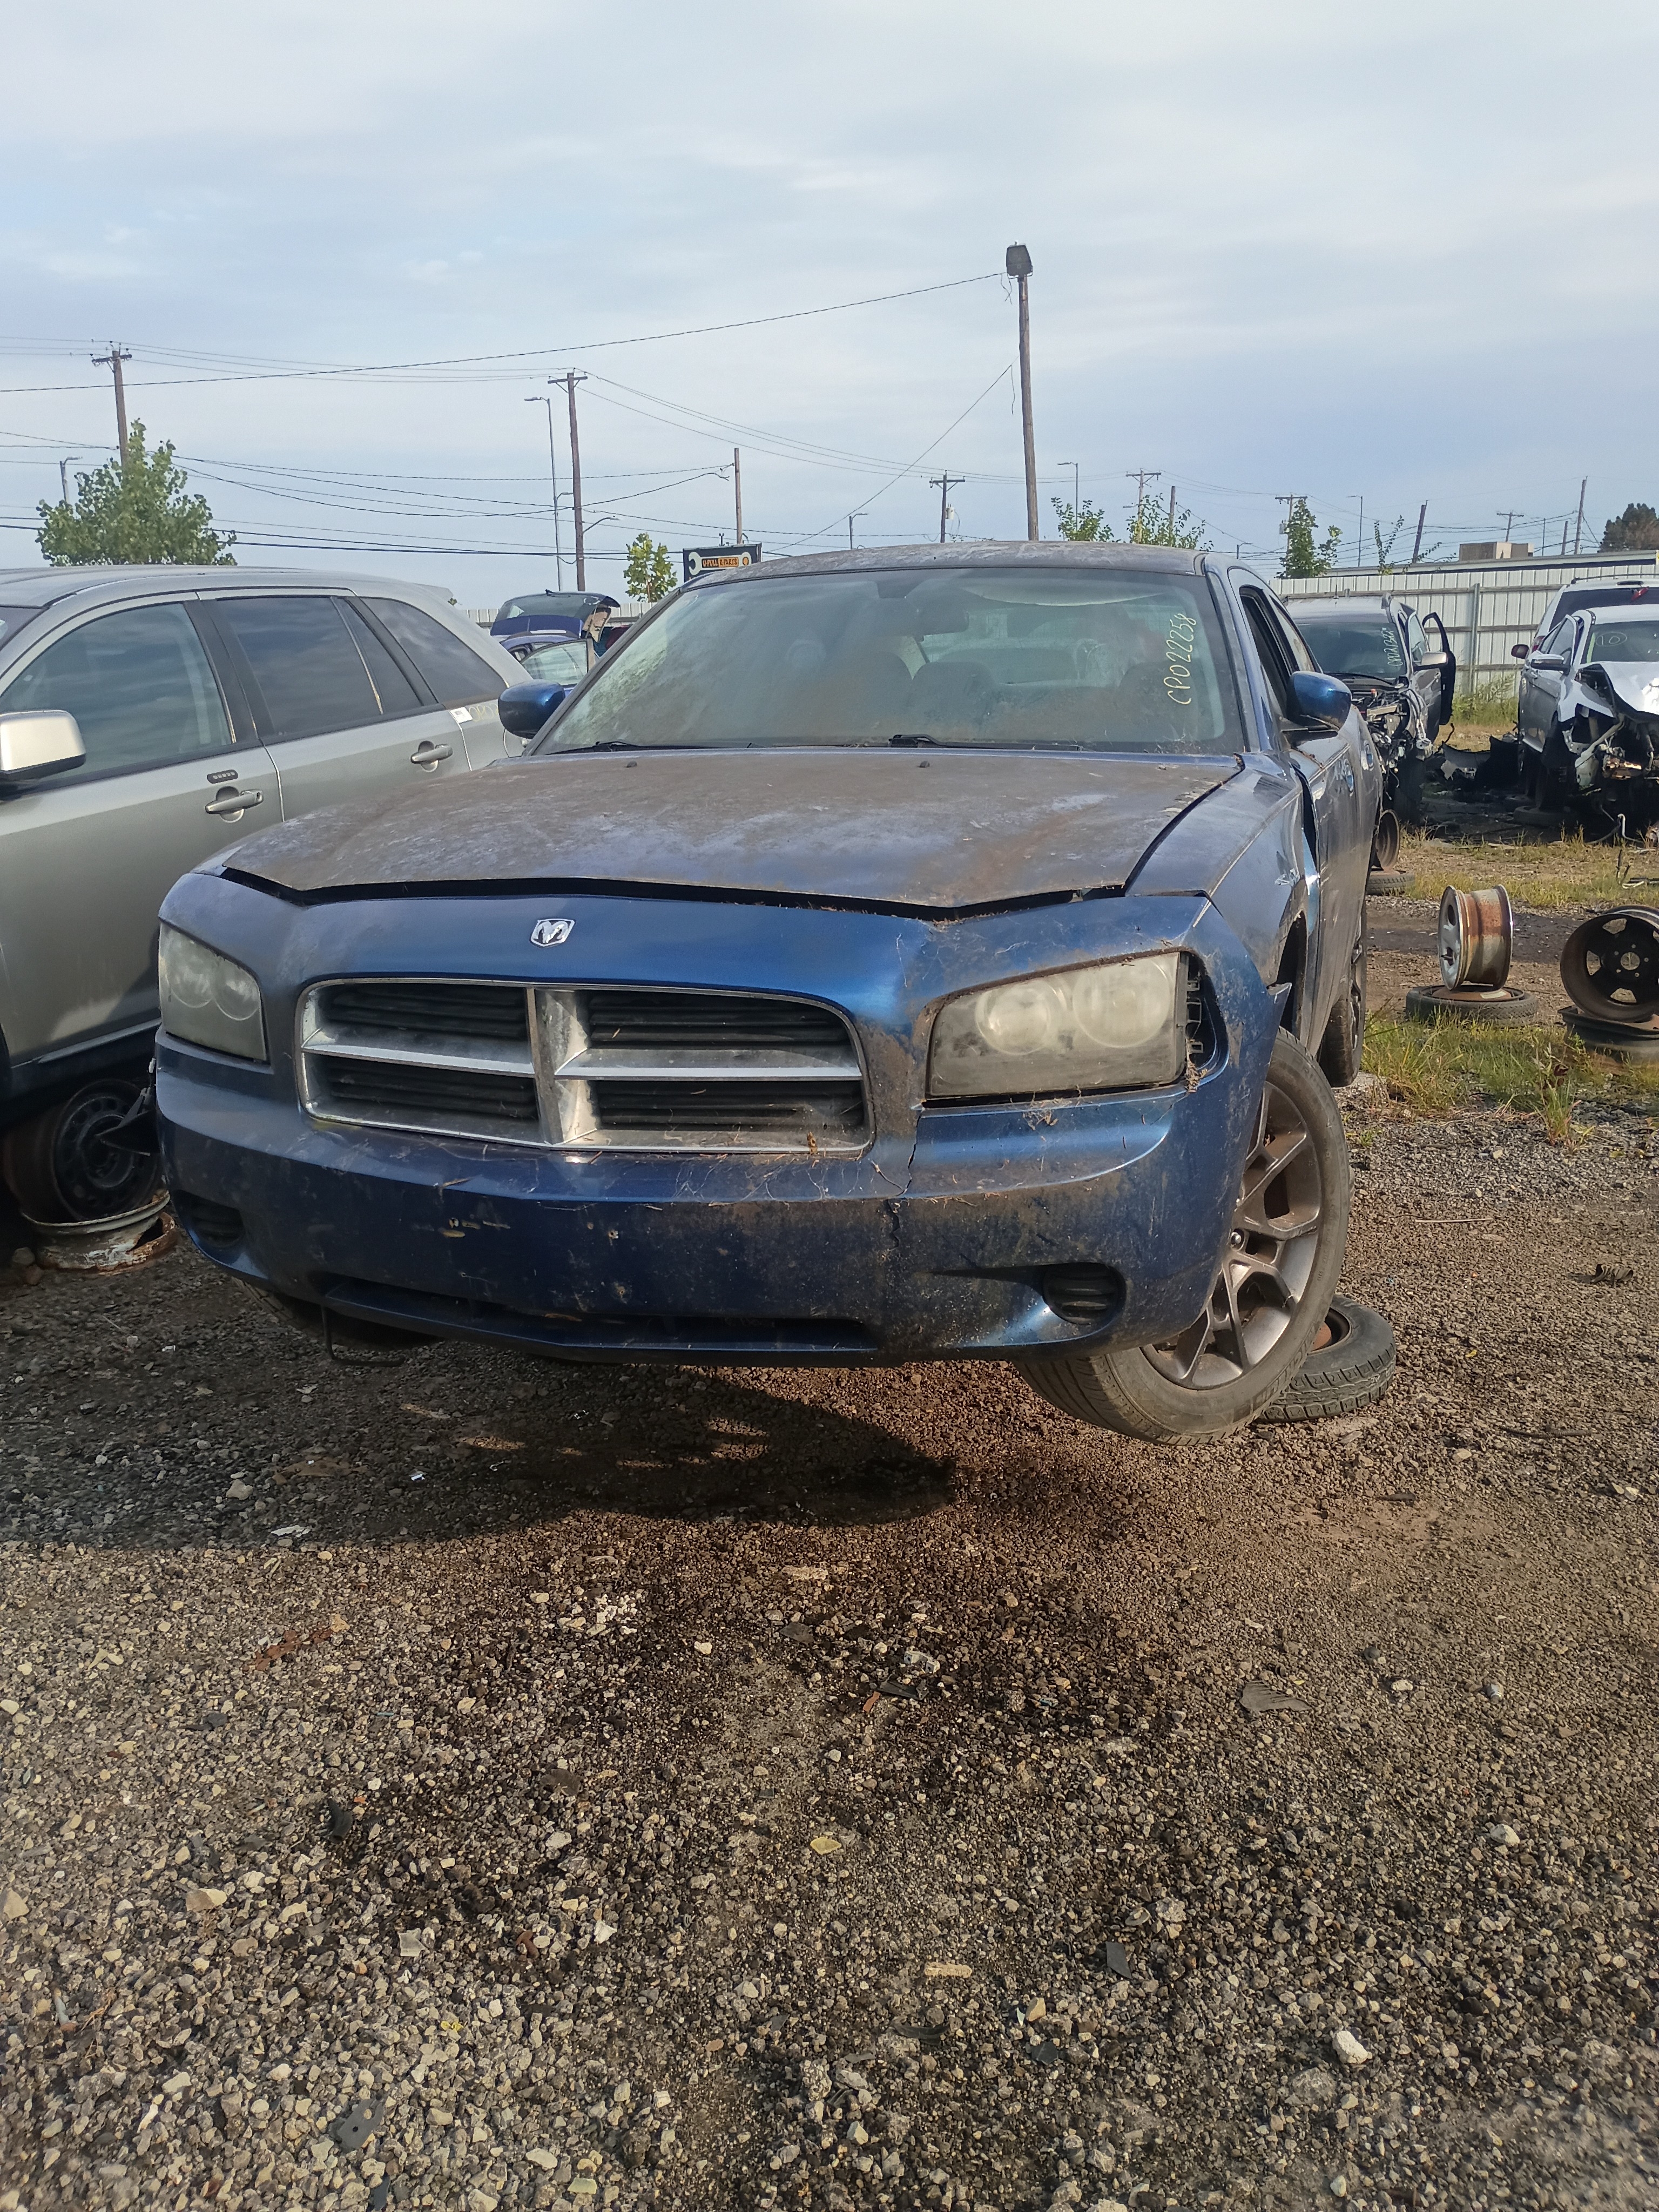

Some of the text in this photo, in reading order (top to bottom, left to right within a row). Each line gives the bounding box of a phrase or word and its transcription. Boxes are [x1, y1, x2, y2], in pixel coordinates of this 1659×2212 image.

[703, 558, 737, 567] U-PULL R-PARTS
[1163, 613, 1197, 704] CP022258
